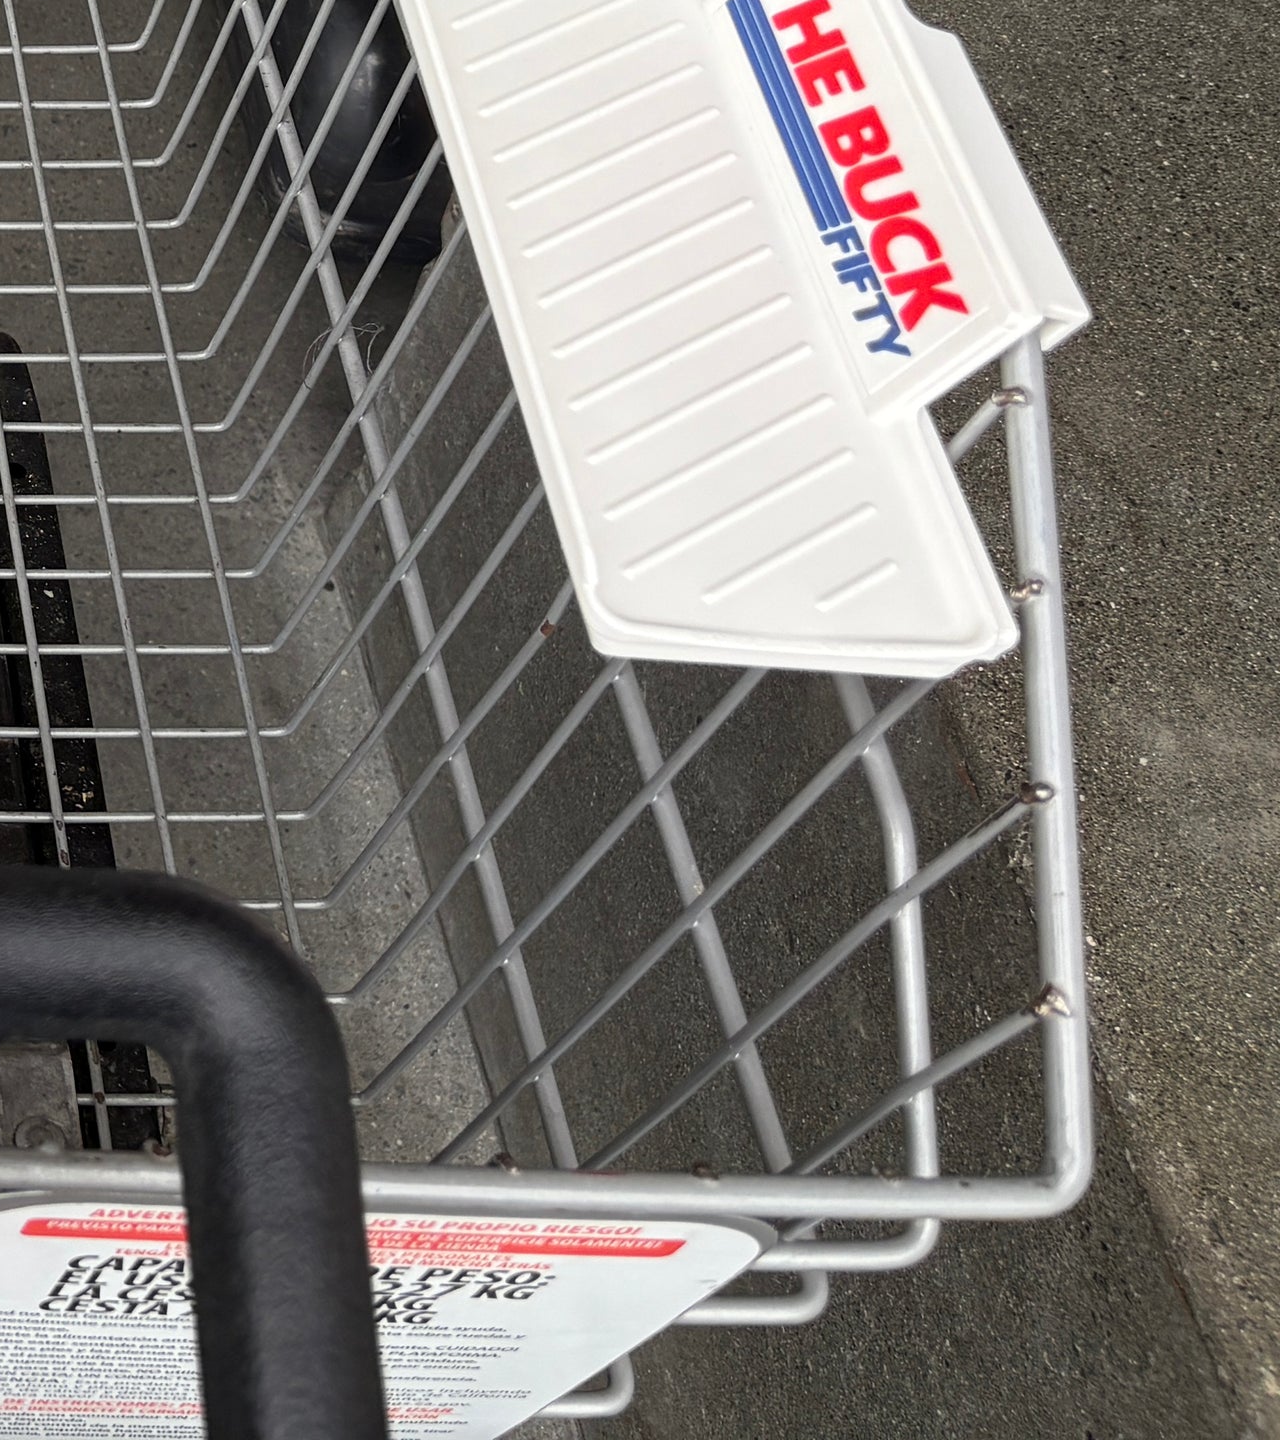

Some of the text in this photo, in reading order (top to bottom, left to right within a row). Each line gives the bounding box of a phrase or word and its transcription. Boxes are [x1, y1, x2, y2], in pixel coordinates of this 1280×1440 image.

[818, 105, 969, 333] BUCK
[821, 226, 912, 357] FIFTY
[400, 1219, 437, 1229] SU
[441, 1221, 538, 1233] PROPIO
[58, 1269, 108, 1286] EL
[470, 1283, 543, 1300] KG
[417, 1267, 557, 1287] PESO:
[47, 1283, 101, 1299] LA
[39, 1297, 169, 1316] CESTA
